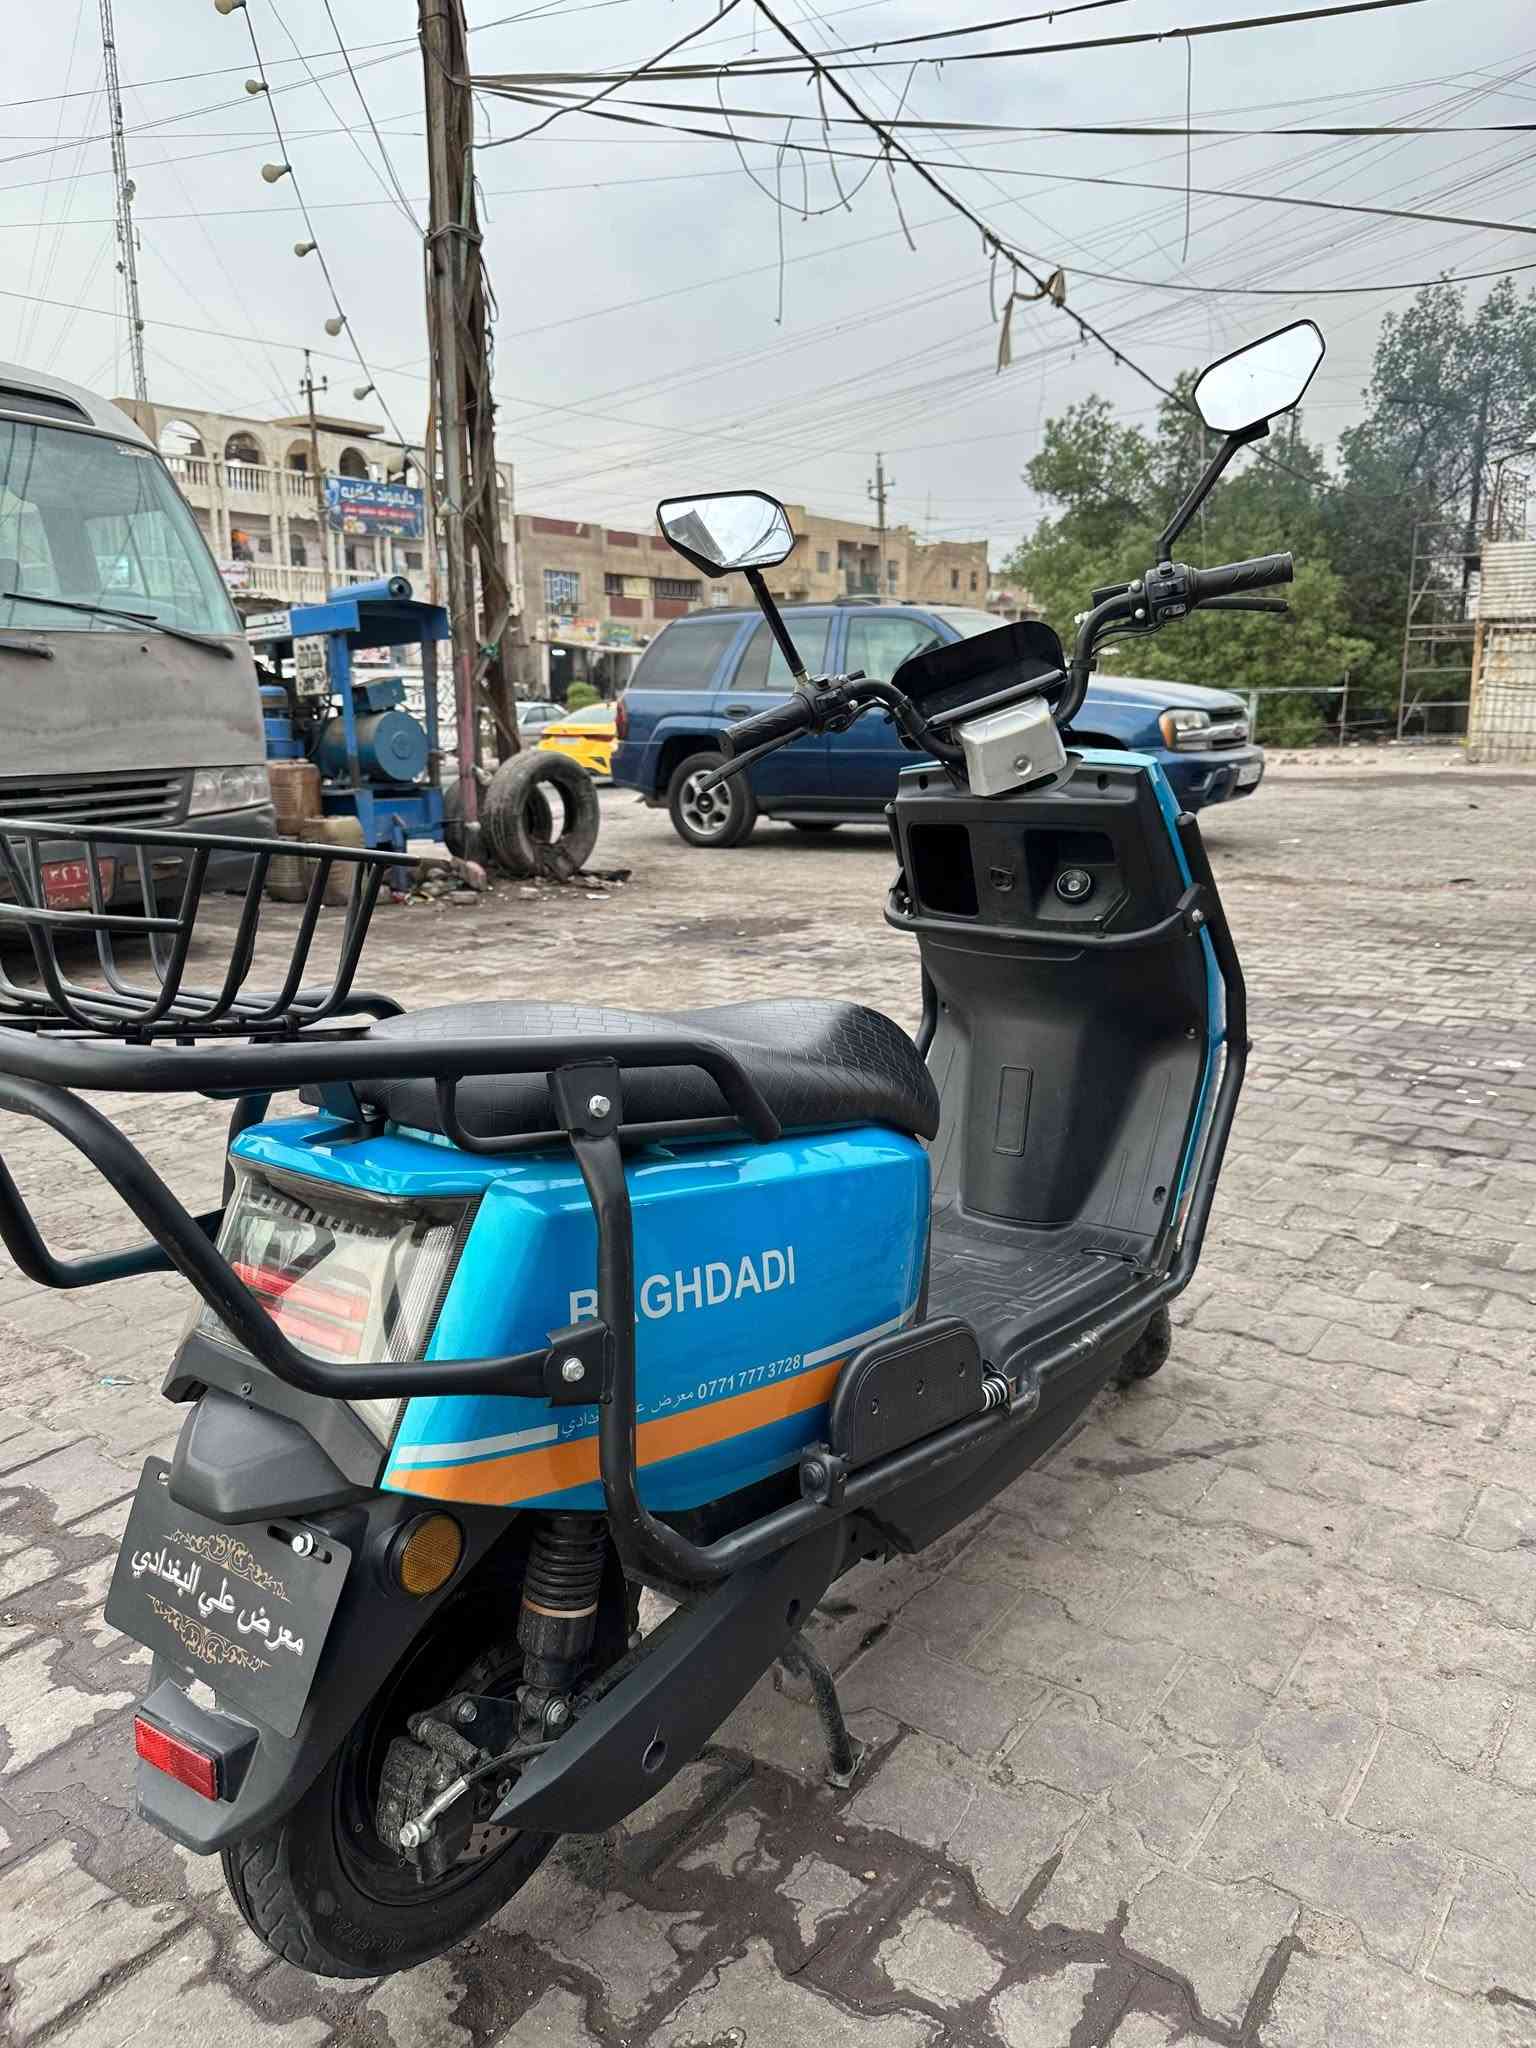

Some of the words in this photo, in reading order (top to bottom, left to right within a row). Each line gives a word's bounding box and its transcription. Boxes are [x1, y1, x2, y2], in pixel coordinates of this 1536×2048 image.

[569, 1246, 795, 1325] BGHDADI
[739, 1366, 764, 1388] 777
[768, 1354, 801, 1379] 3728
[650, 1391, 694, 1413] معرض
[698, 1374, 735, 1400] 0771
[131, 1547, 202, 1597] البغدادي
[198, 1577, 236, 1618] علي
[237, 1607, 304, 1656] معرض
